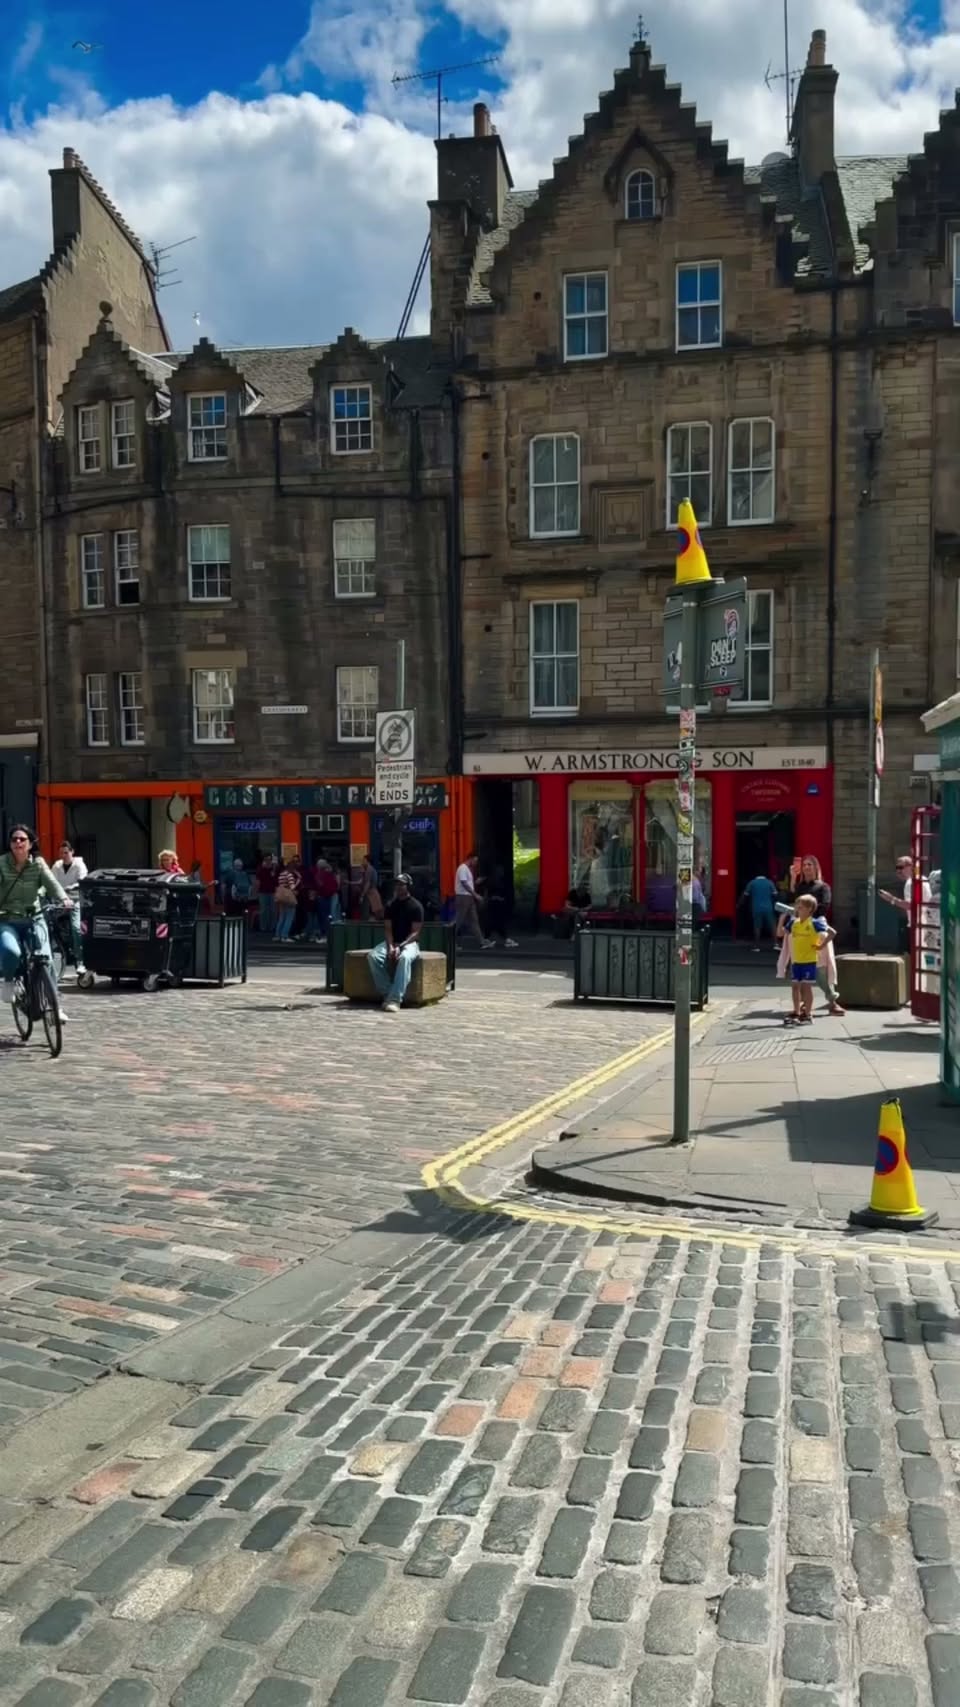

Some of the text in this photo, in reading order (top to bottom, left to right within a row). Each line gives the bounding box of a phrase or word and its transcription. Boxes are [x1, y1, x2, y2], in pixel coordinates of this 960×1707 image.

[710, 650, 737, 667] SLEEP
[524, 755, 546, 771] W.
[551, 753, 681, 771] ARMSTRONG
[712, 751, 754, 768] SON
[377, 763, 411, 773] Pedestrian
[392, 772, 409, 781] cycle
[387, 781, 402, 789] Zone
[380, 790, 409, 801] ENDS
[235, 821, 267, 831] PIZZAS
